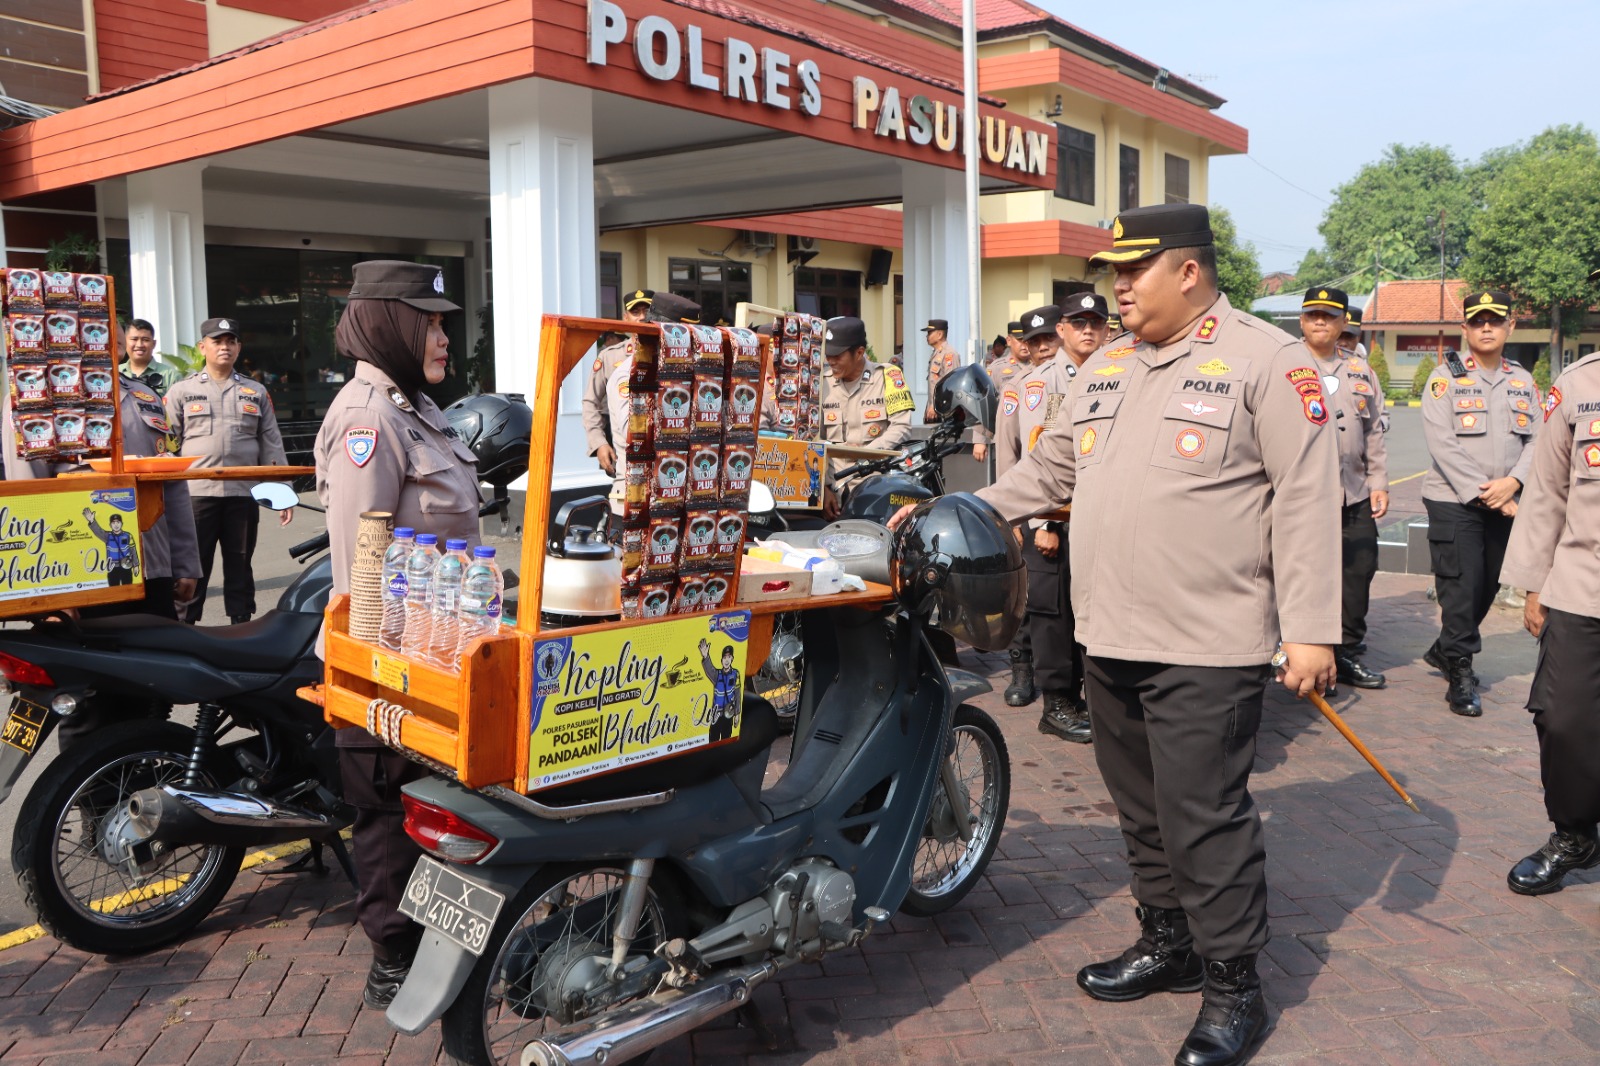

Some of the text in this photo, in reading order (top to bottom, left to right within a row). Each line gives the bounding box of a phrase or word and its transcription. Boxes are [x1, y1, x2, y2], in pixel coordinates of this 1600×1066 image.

[587, 0, 1048, 176] POLRES PASUUAN
[52, 286, 69, 294] PLUS
[670, 348, 688, 358] PLUS
[704, 343, 720, 353] PLUS
[742, 347, 756, 356] PLUS
[1087, 380, 1120, 393] DANI
[1182, 380, 1231, 395] POLRI
[1507, 389, 1530, 397] POLRI
[861, 397, 884, 406] POLRI
[669, 408, 684, 416] TOP
[701, 413, 718, 422] PLUS
[666, 419, 685, 428] PLUS
[30, 440, 49, 448] PLUS
[90, 439, 107, 447] PLUS
[700, 470, 713, 478] TOP
[732, 470, 746, 479] TOP
[697, 480, 713, 490] PLUS
[730, 481, 746, 490] PLUS
[661, 488, 680, 498] PLUS
[691, 546, 708, 555] PLUS
[719, 544, 734, 553] PLUS
[654, 554, 672, 564] PLUS
[563, 641, 667, 711] Kopling
[555, 703, 574, 713] KOPI
[614, 689, 641, 701] GRATIS
[25, 706, 32, 717] X
[542, 717, 599, 735] POLRES PASURUAN
[603, 703, 679, 754] Bhabin
[553, 725, 599, 747] POLSEK
[538, 742, 598, 768] PANDAAN
[458, 883, 476, 906] X
[428, 899, 487, 948] 4107-39
